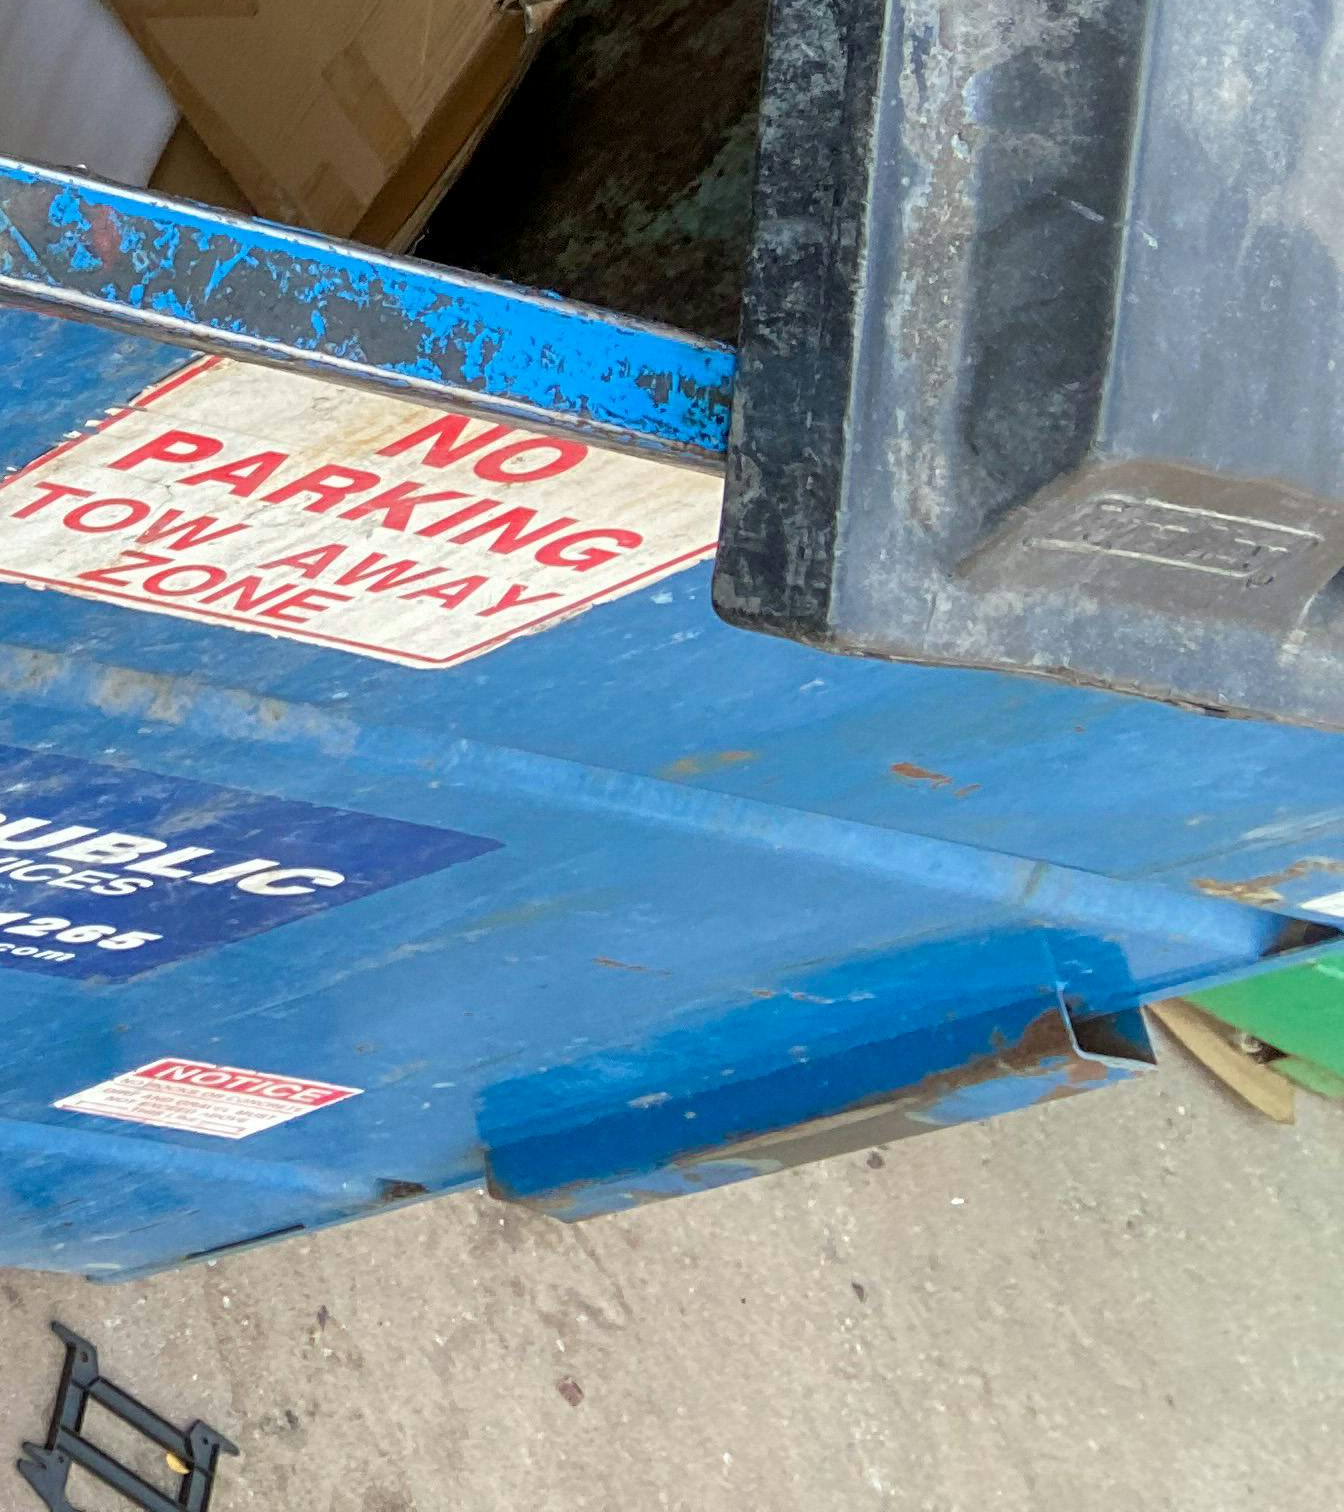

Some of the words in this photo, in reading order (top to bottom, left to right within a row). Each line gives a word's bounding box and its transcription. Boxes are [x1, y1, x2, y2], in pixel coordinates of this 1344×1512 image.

[374, 413, 589, 484] NO
[109, 429, 645, 573] PARKING
[10, 481, 251, 546] TOW
[280, 543, 565, 619] AWAY
[78, 549, 356, 624] ZONE
[154, 1064, 334, 1104] NOTICE
